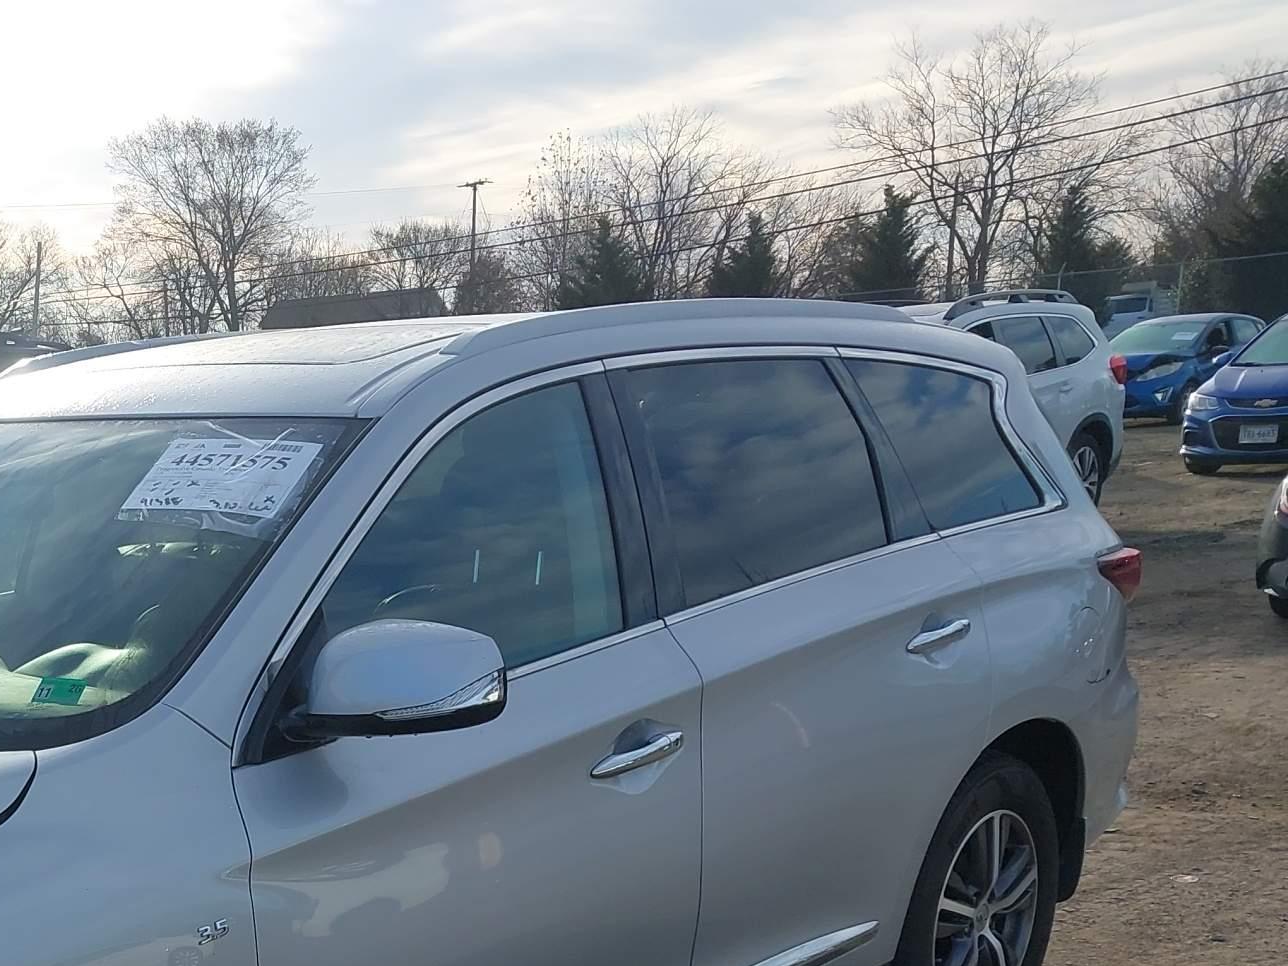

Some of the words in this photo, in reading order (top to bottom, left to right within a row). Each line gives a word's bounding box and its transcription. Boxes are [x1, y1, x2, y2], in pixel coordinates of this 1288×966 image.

[170, 453, 291, 470] 44571575
[37, 687, 52, 698] 11
[197, 918, 229, 945] 3.5
